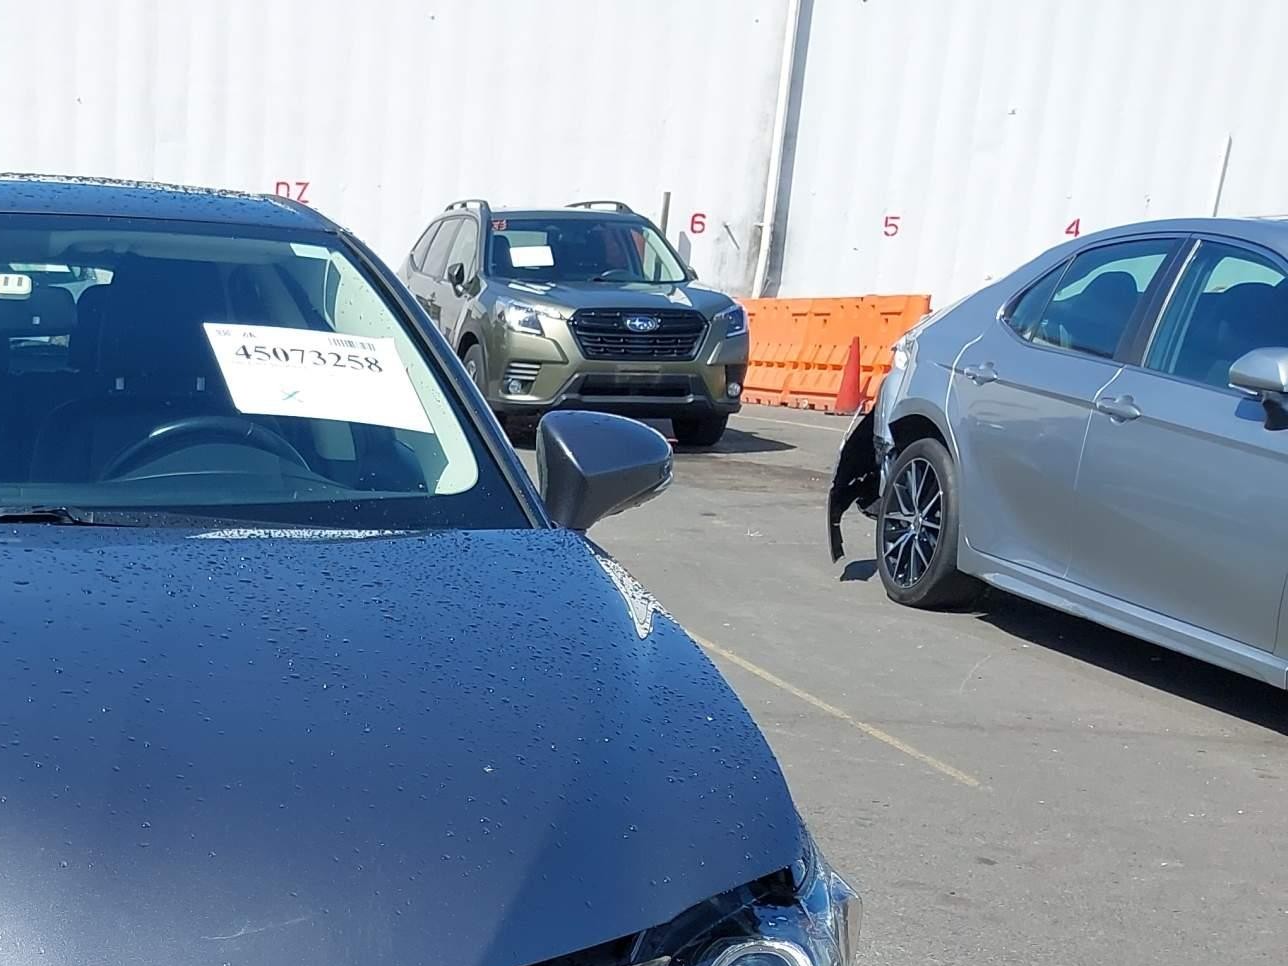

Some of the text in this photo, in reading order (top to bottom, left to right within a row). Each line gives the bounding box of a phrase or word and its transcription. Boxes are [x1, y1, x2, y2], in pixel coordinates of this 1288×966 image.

[690, 213, 706, 234] 6
[883, 216, 900, 237] 5
[1065, 218, 1080, 237] 4
[234, 344, 383, 373] 45073258
